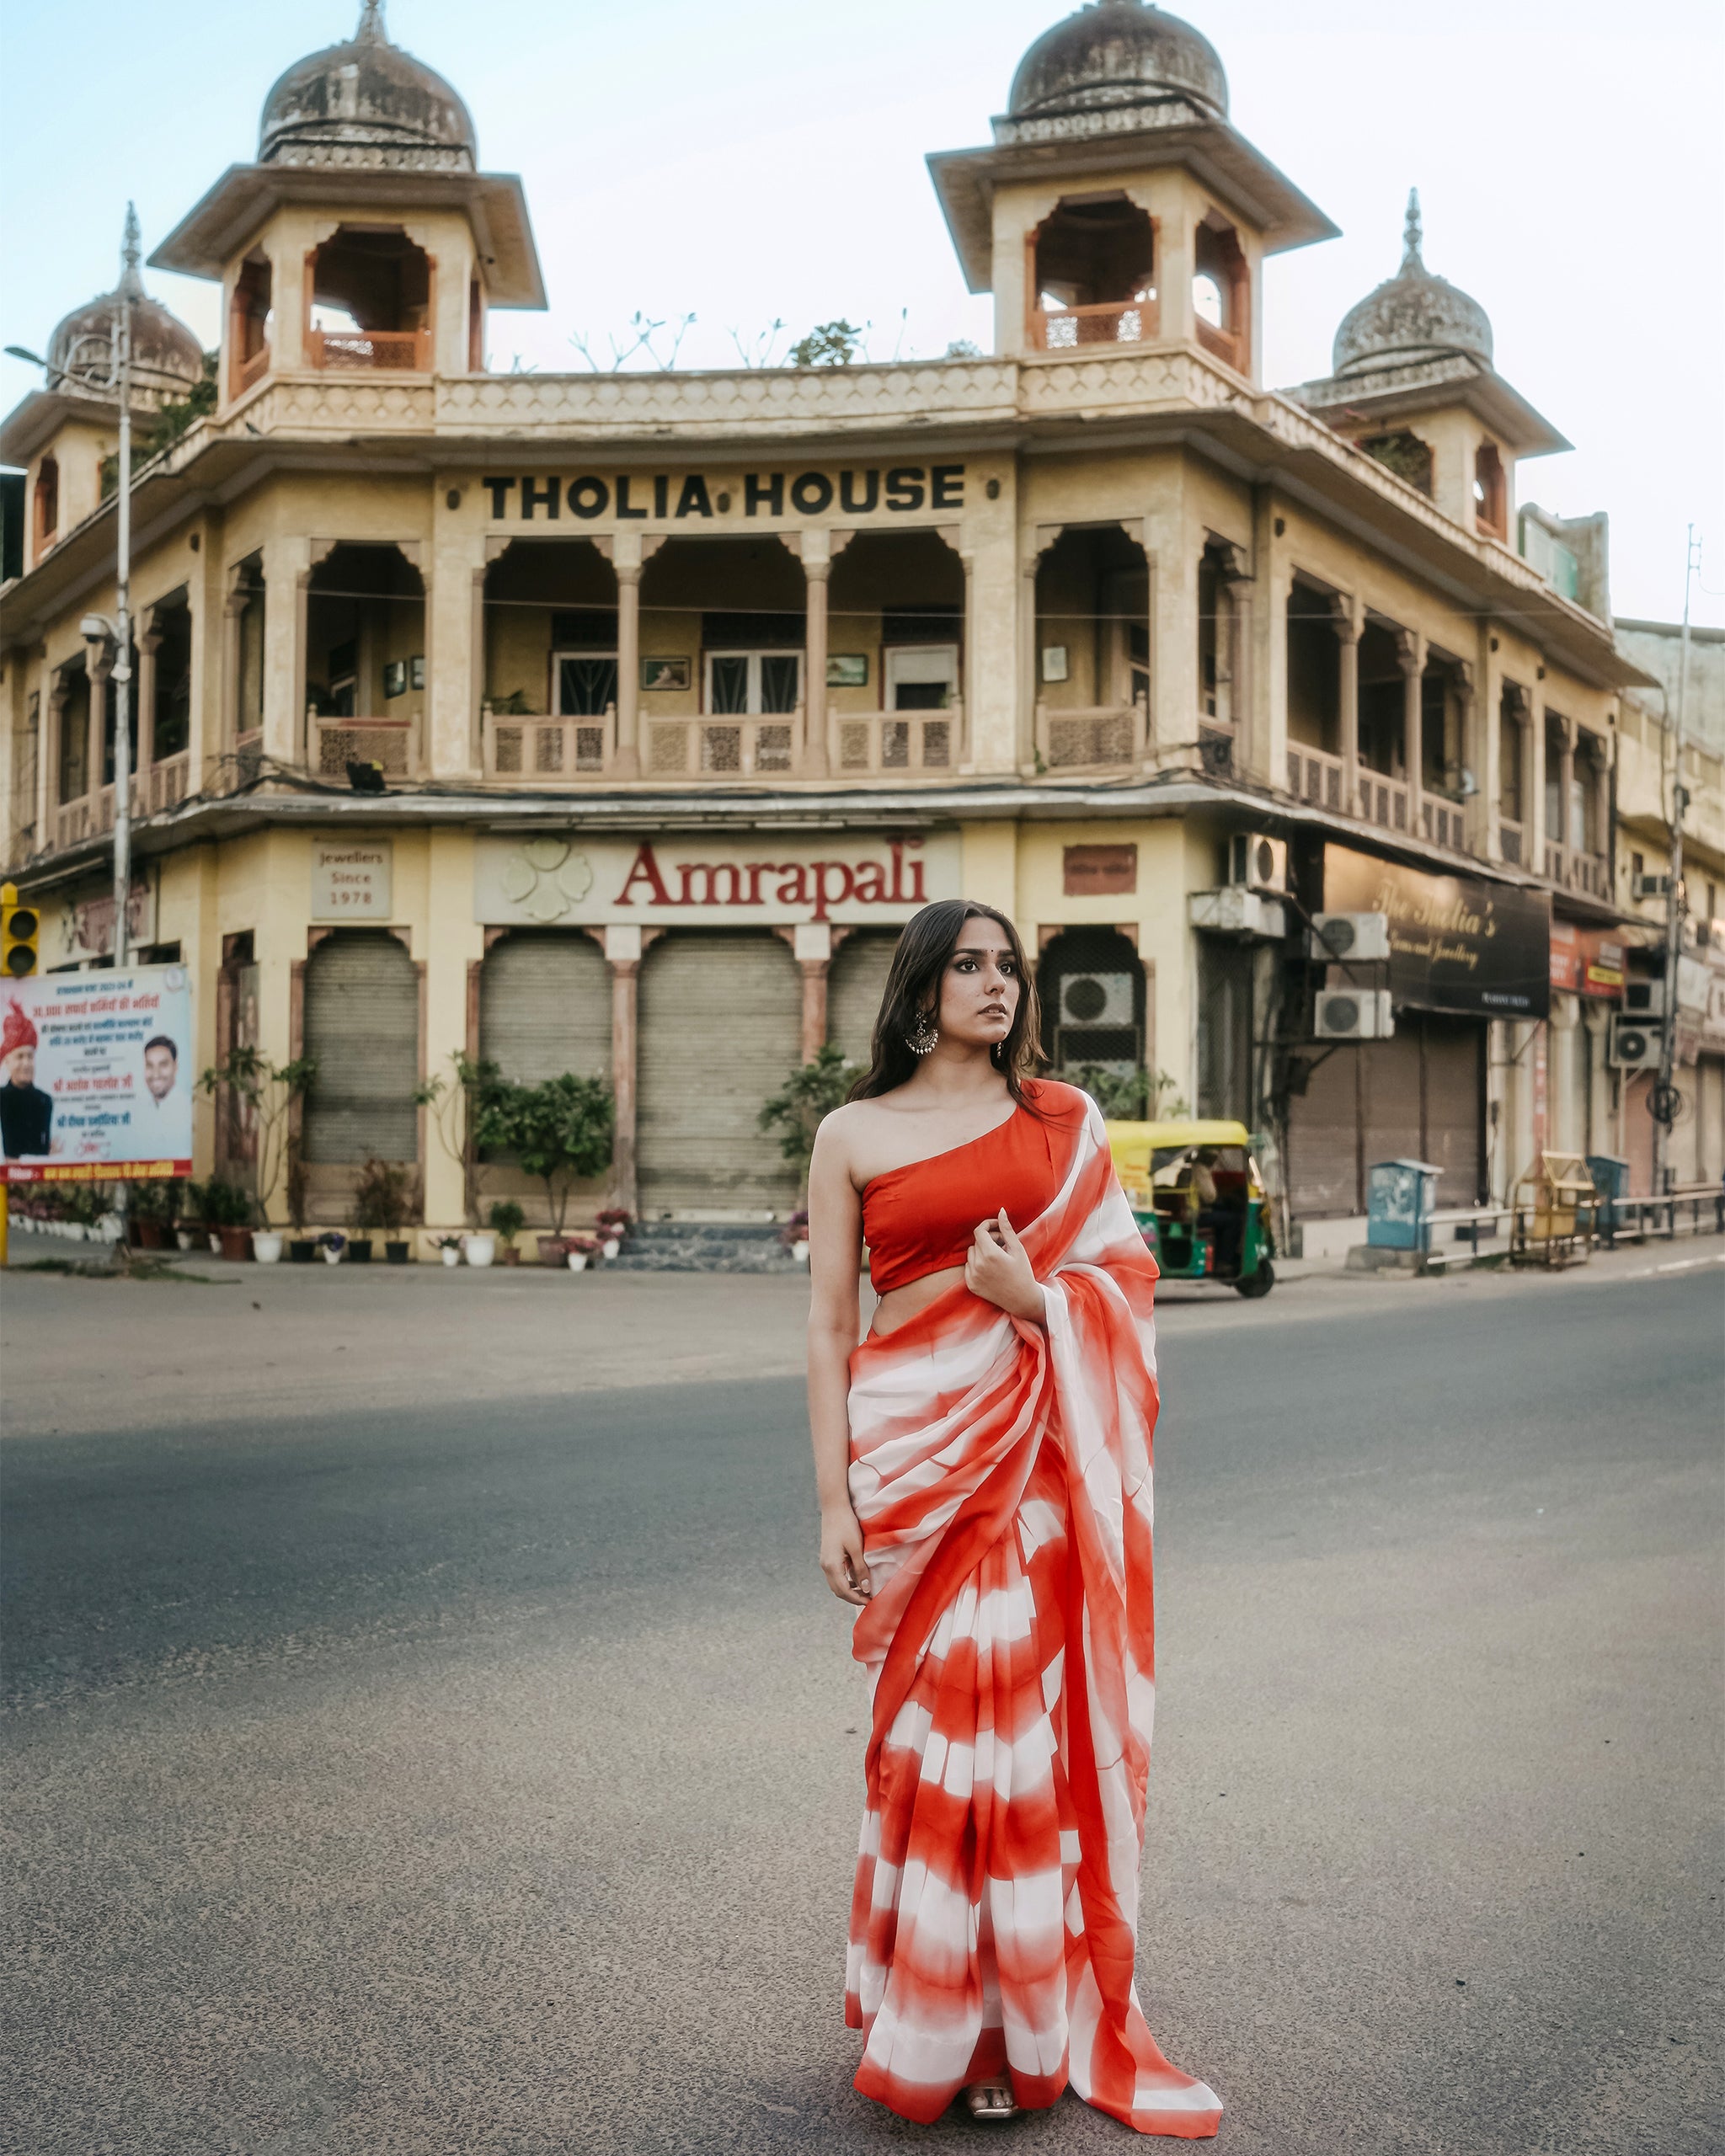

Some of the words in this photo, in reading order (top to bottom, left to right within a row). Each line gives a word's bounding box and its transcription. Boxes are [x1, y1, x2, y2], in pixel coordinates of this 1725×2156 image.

[483, 475, 713, 520] THOLIA
[745, 465, 965, 517] HOUSE
[331, 871, 371, 884] Since
[612, 835, 928, 922] Amrapali
[331, 891, 372, 905] 1978
